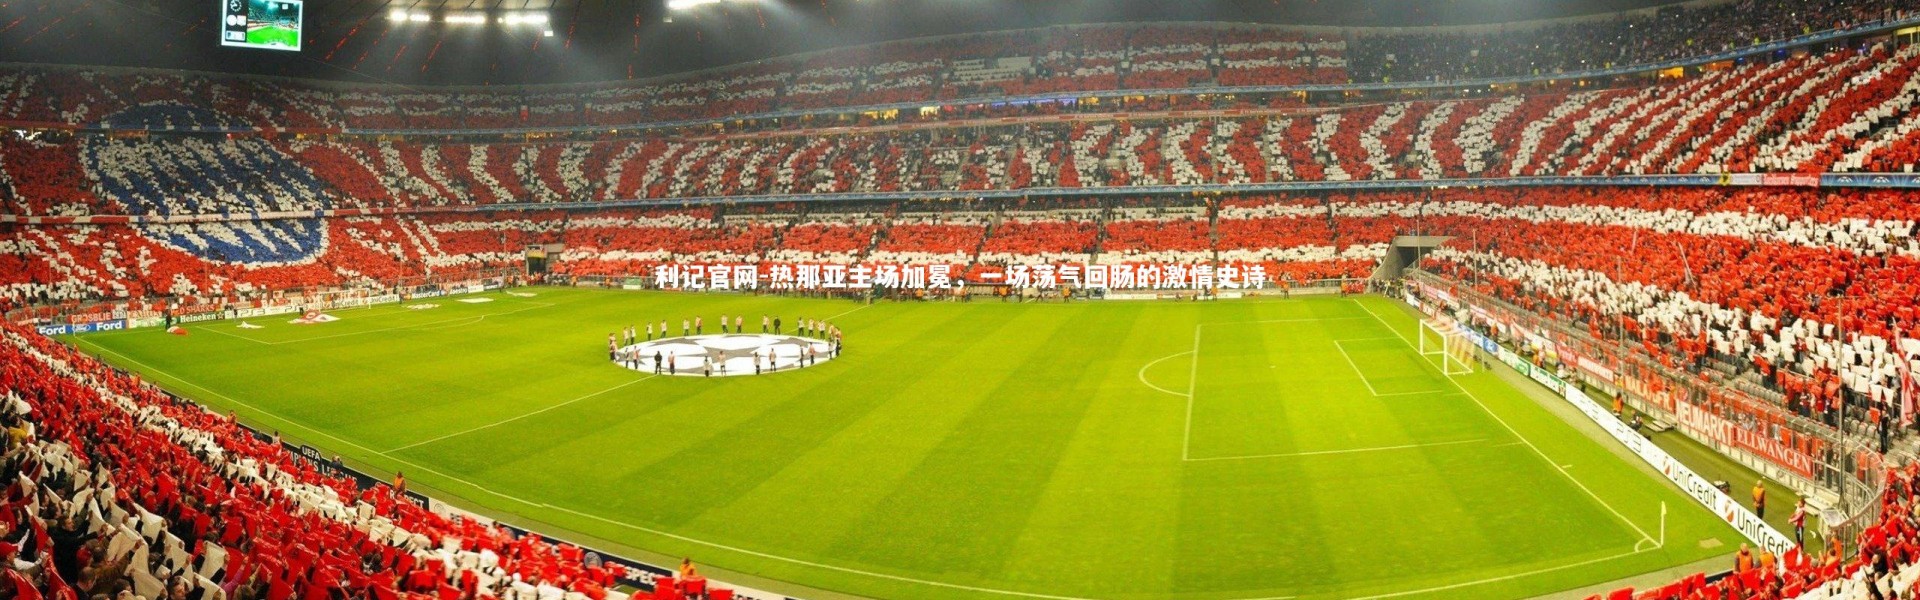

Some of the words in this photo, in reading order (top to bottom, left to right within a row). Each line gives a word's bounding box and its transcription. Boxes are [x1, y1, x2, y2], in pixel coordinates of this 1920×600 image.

[96, 321, 123, 332] Ford
[180, 313, 217, 324] Heineken
[39, 325, 66, 336] Ford
[1676, 399, 1734, 446] NEUMARKT
[1616, 421, 1641, 453] PS3
[302, 446, 321, 461] UEFA
[1737, 425, 1812, 474] ELLWANGEN
[1672, 462, 1717, 511] UniCredit
